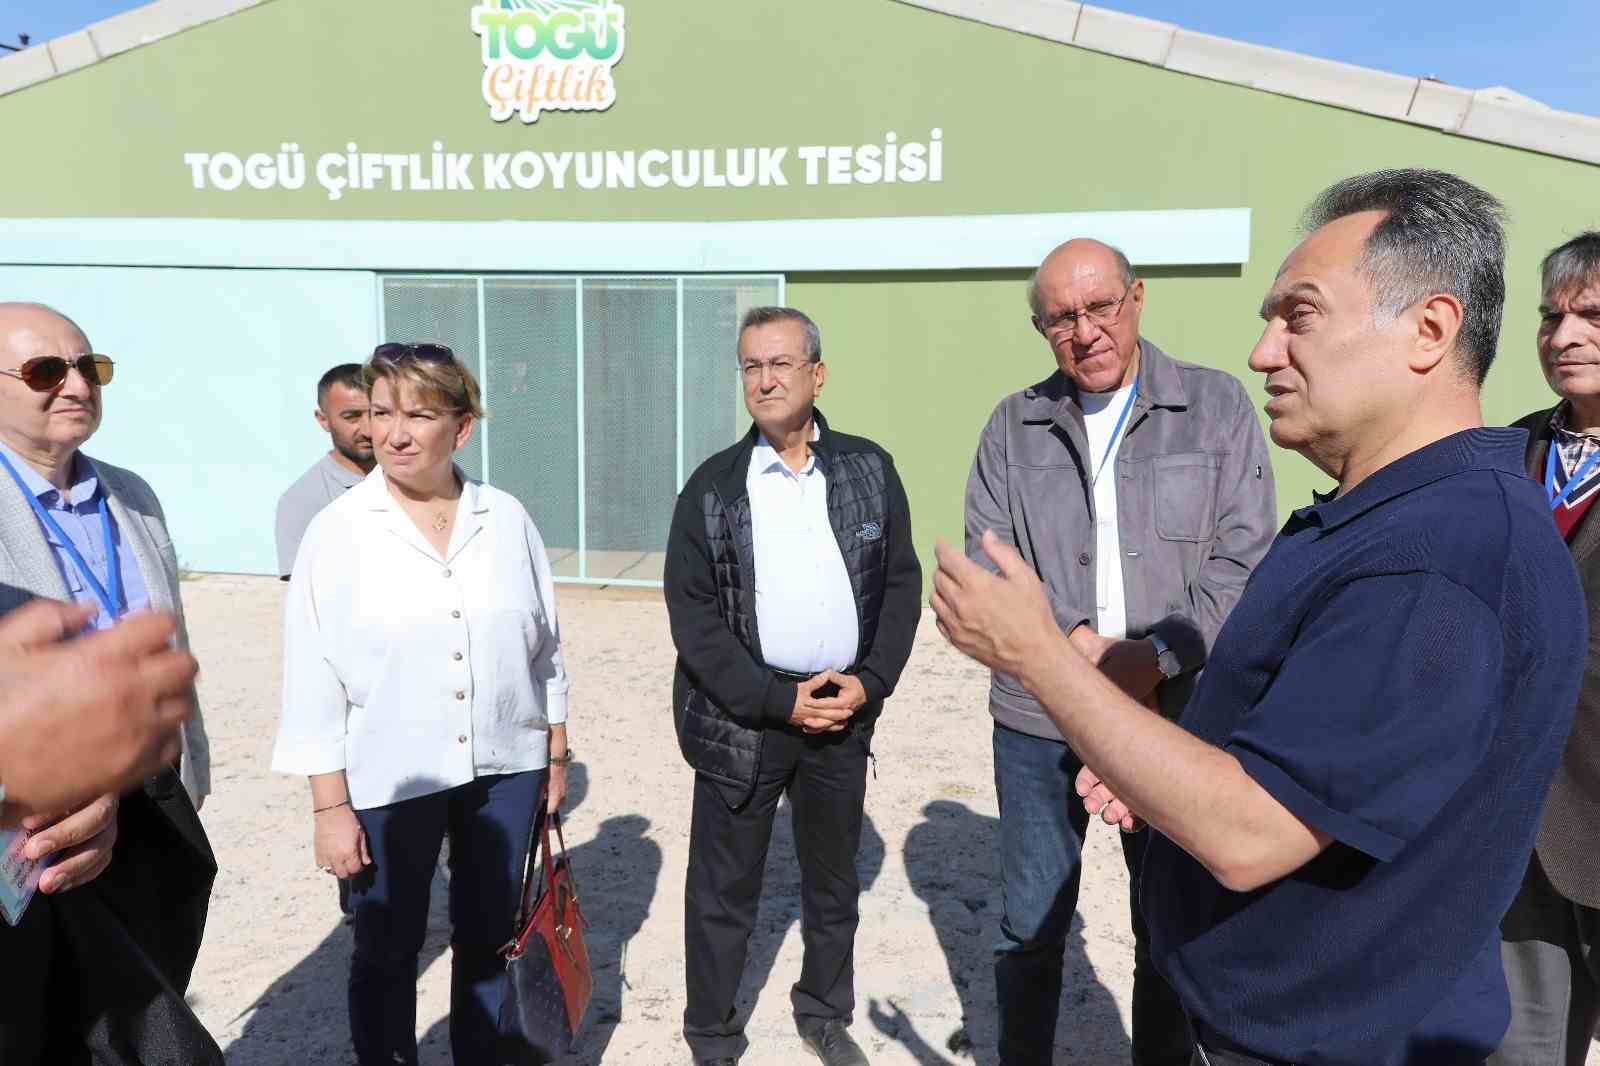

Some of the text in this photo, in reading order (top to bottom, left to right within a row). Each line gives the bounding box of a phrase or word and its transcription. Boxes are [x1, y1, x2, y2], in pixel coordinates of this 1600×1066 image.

[479, 11, 618, 60] TOGÜ
[488, 64, 608, 114] Çiftlik
[184, 127, 943, 201] TOGÜ ÇİFTLİK KOYUNCULUK TESİSİ
